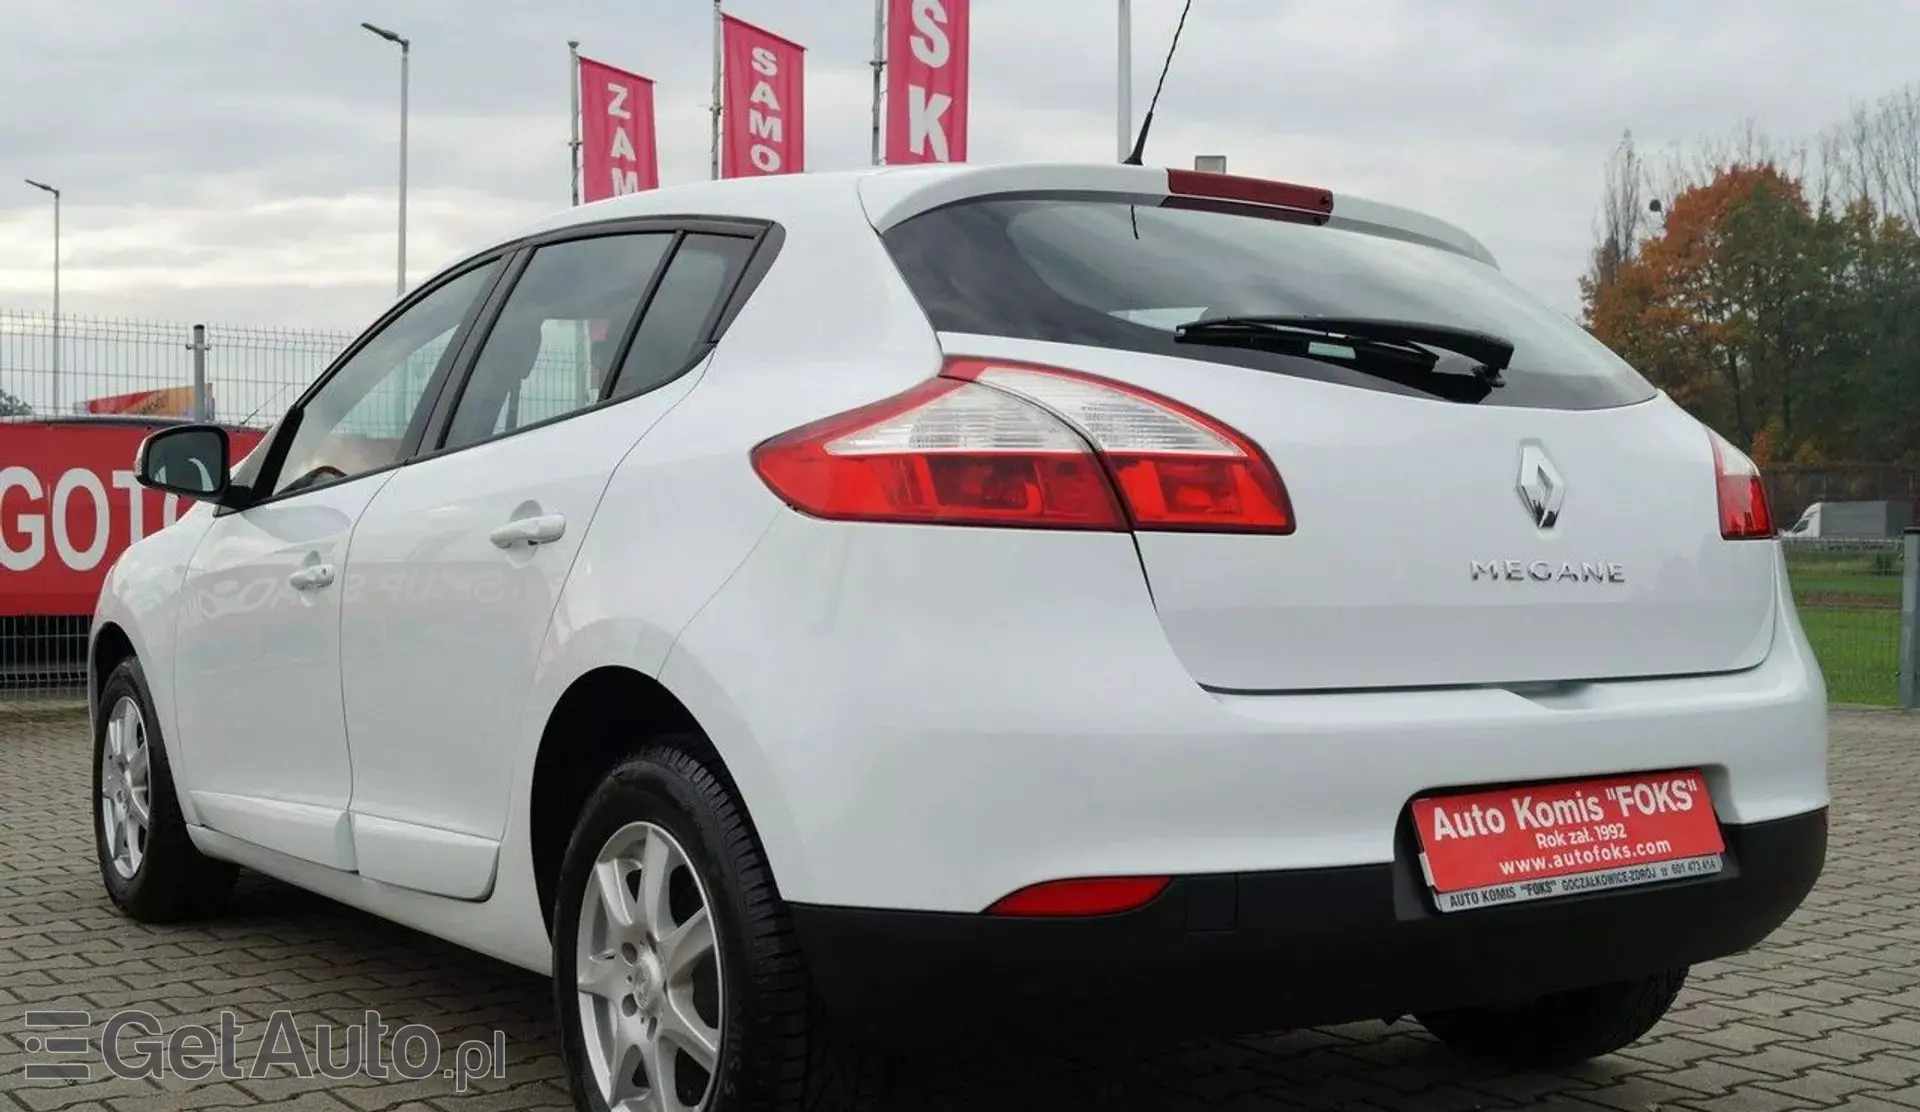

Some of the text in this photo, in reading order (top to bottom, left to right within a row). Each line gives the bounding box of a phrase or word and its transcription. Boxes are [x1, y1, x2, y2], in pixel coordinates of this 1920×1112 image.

[748, 47, 783, 172] SAMO
[909, 0, 952, 163] SK
[607, 82, 639, 197] ZAM
[0, 466, 178, 571] GOT
[1470, 558, 1626, 583] MEGANE
[1433, 778, 1698, 841] Auto Komis "FOKS"
[1535, 822, 1628, 849] Rok zał. 1992
[1498, 839, 1672, 876] www.autofoks.com
[1449, 891, 1480, 908] AUTO
[1480, 886, 1517, 904] KOMIS
